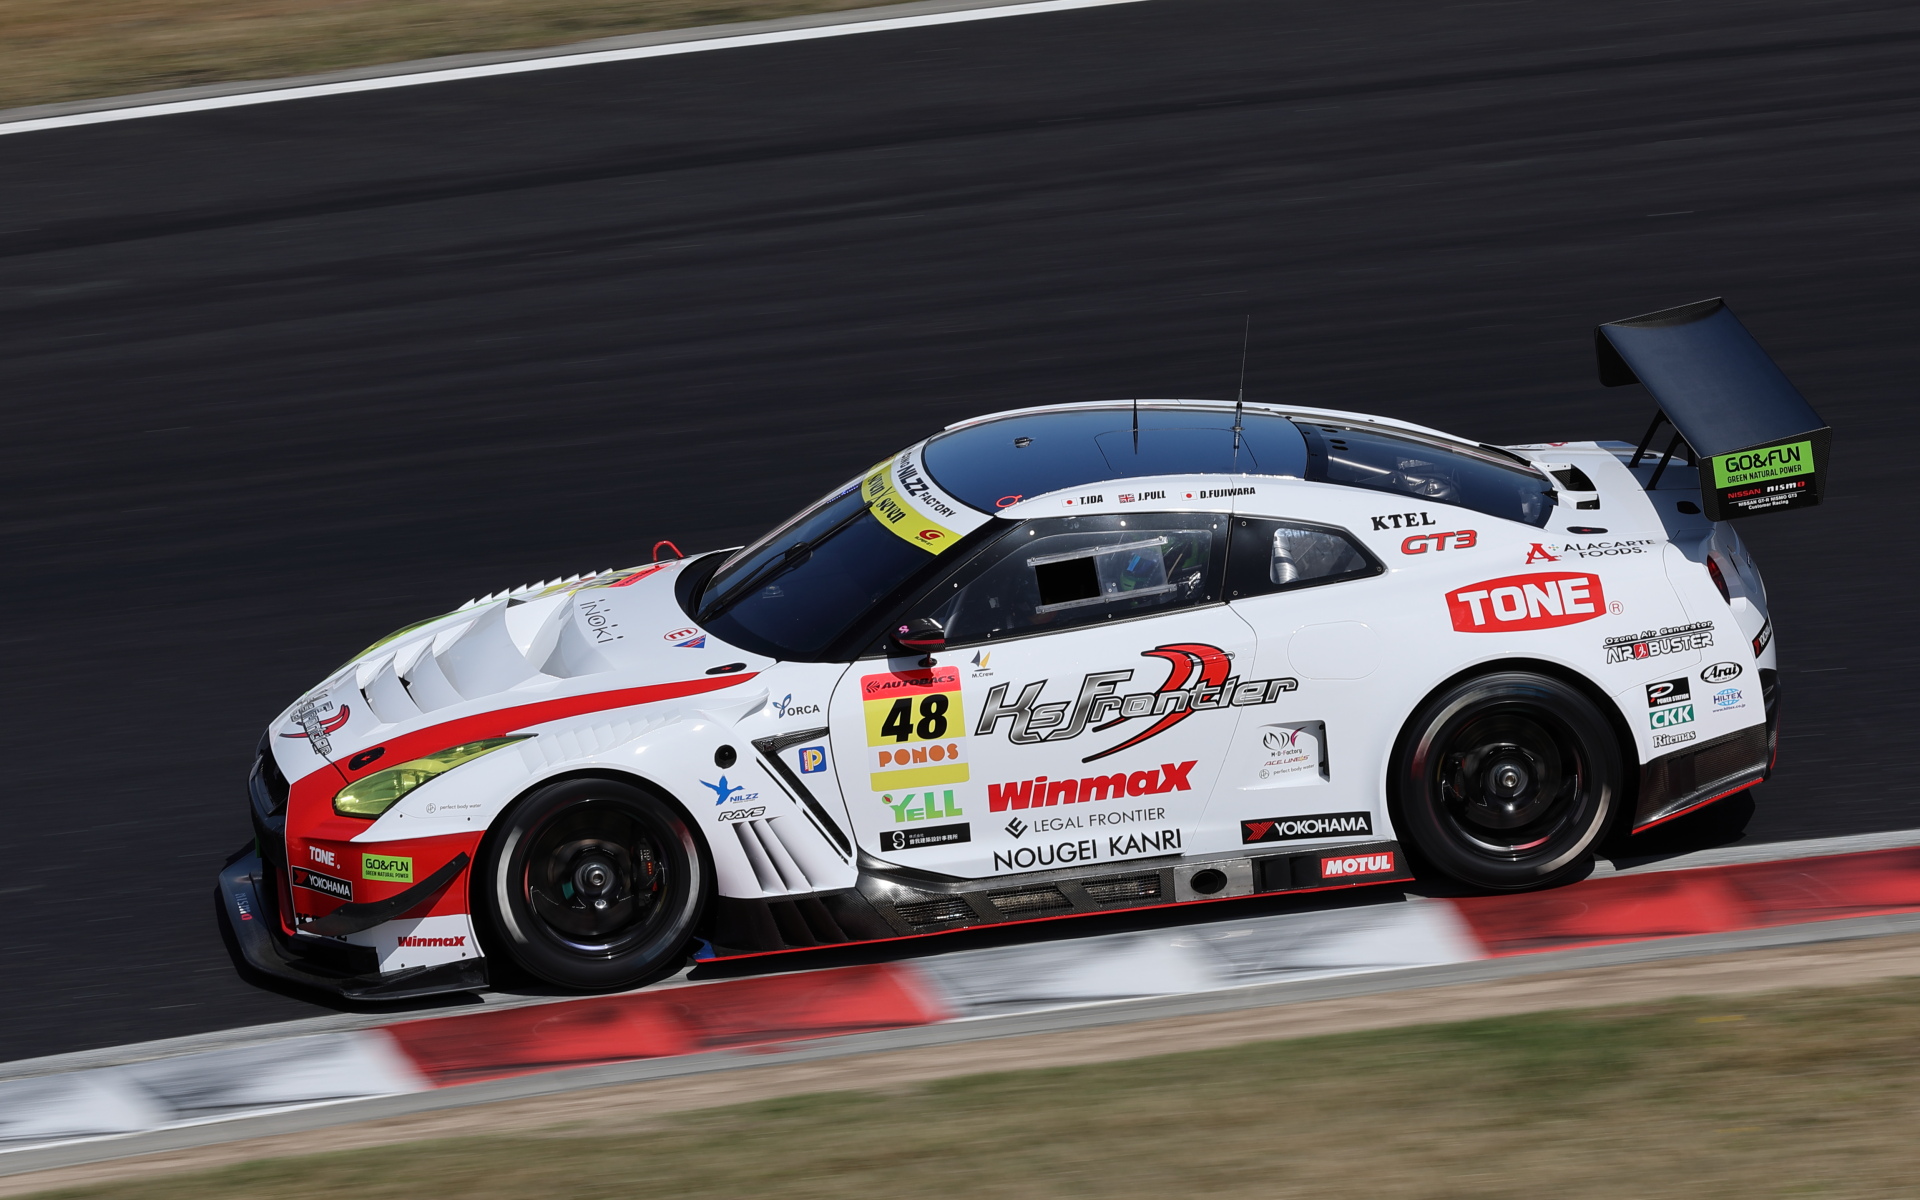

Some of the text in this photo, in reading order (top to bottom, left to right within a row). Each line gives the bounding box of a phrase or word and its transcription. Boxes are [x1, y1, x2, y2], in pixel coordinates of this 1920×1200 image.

[1725, 446, 1801, 473] GO&FUN
[1727, 464, 1802, 484] GREEN NATURAL POWER
[896, 463, 930, 497] NILZZ
[918, 491, 957, 518] FACTORY
[1137, 490, 1167, 502] J.PULL
[1199, 486, 1256, 500] D.FUJIWARA
[1727, 488, 1761, 499] NISSAN
[1079, 494, 1104, 506] T.IDA
[1738, 499, 1757, 507] NISSAN
[1748, 499, 1789, 510] Customer Racing
[876, 497, 907, 524] seven
[1371, 512, 1436, 531] KTEL
[1400, 529, 1478, 555] GT3
[1563, 539, 1656, 552] ALACARTE
[1578, 548, 1648, 559] FOODS.
[1456, 577, 1595, 626] TONE
[1604, 620, 1713, 645] Ozone Air Generator
[1606, 631, 1714, 664] AIR BUSTER
[1704, 664, 1738, 681] Arai
[880, 675, 955, 690] AUTOBACS
[1713, 690, 1743, 705] HILTEX
[787, 704, 821, 717] ORCA
[880, 693, 949, 743] 48
[1651, 705, 1693, 728] CKK
[1652, 730, 1697, 748] Ritemas
[878, 743, 959, 767] PONOS
[1263, 759, 1283, 767] ACE
[1273, 768, 1290, 776] perfect
[1291, 765, 1302, 773] body
[729, 793, 759, 803] NILZZ
[718, 806, 766, 822] RAYS
[1034, 816, 1083, 833] LEGAL
[1089, 807, 1166, 827] FRONTIER
[1274, 816, 1369, 837] YOKOHAMA
[309, 845, 336, 867] TONE
[993, 828, 1182, 872] NOUGEI KANRI
[365, 858, 409, 872] GO&FUN
[1325, 855, 1391, 875] MOTUL
[308, 874, 351, 897] YOKOHAMA
